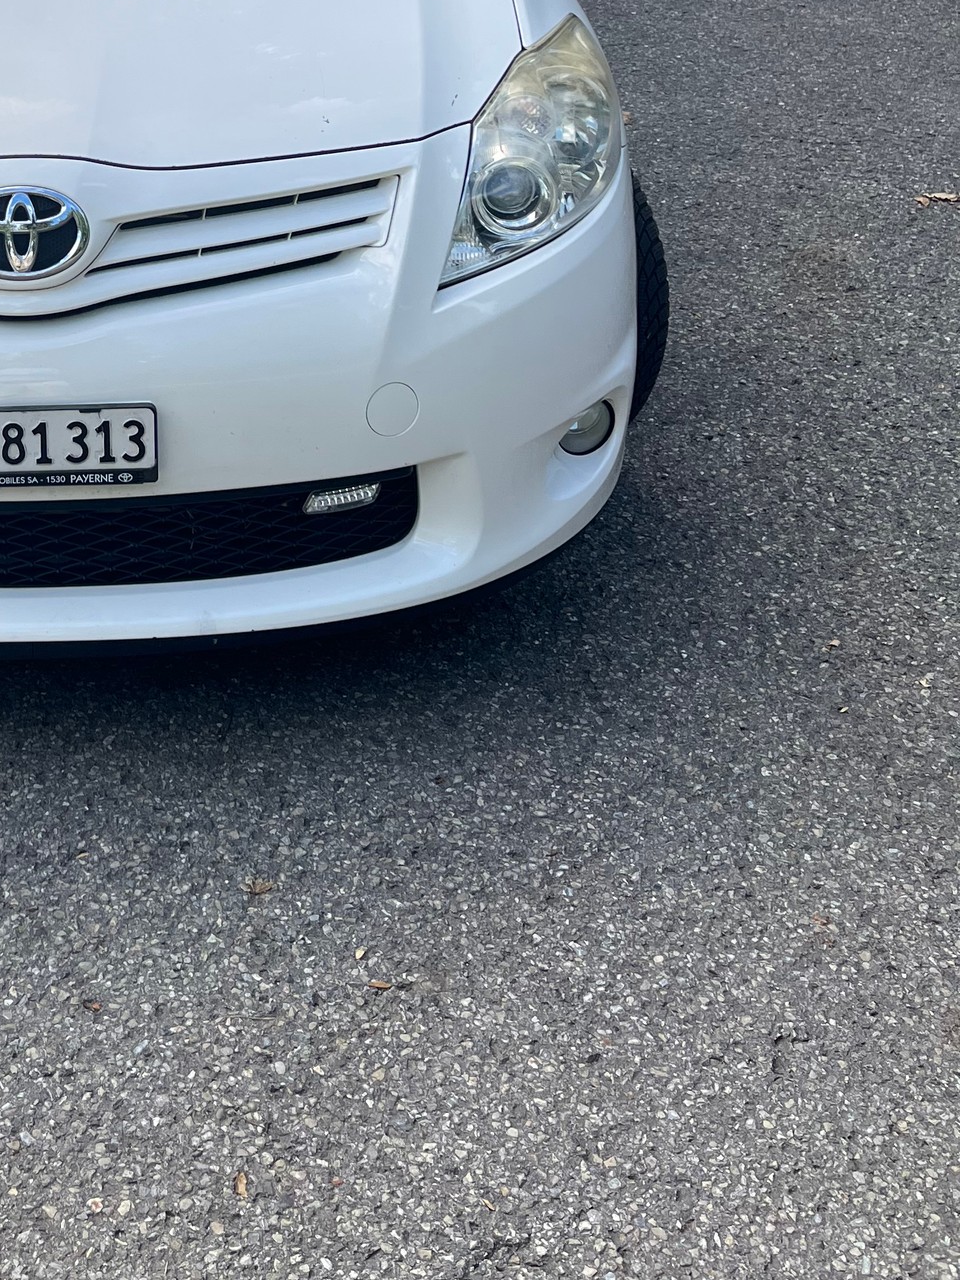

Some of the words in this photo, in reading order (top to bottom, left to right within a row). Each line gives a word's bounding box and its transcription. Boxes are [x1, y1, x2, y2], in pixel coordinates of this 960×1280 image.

[27, 476, 39, 485] SA
[46, 475, 66, 484] 1530
[70, 473, 114, 484] PAYERNE
